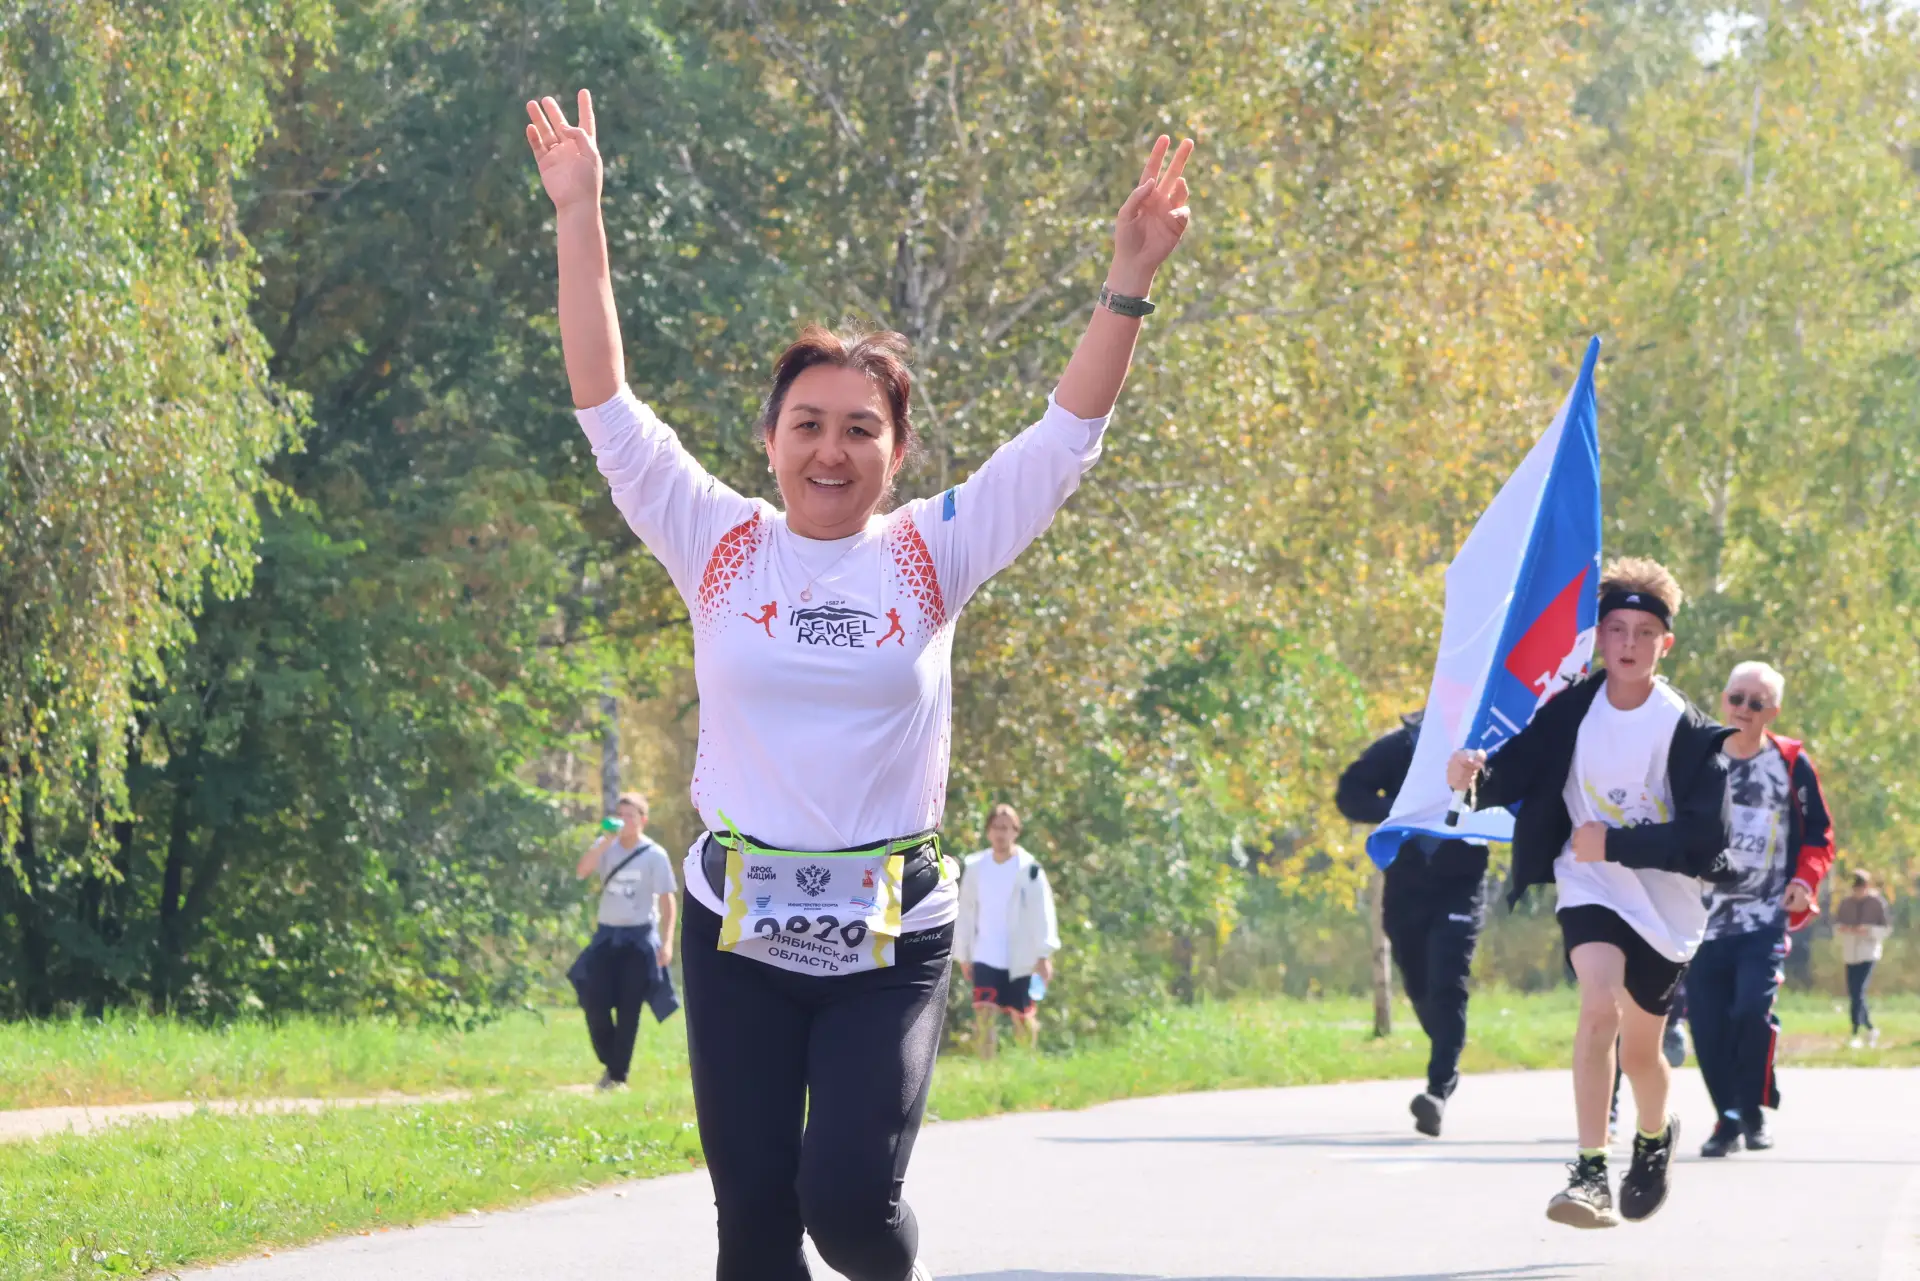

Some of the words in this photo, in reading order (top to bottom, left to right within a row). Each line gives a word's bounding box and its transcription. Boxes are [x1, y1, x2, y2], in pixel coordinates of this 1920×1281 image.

[797, 626, 864, 647] RACE
[747, 872, 776, 881] НАЦИИ
[761, 932, 859, 963] ЛЯБИНСКАЯ
[768, 947, 839, 971] ОБЛАСТЬ
